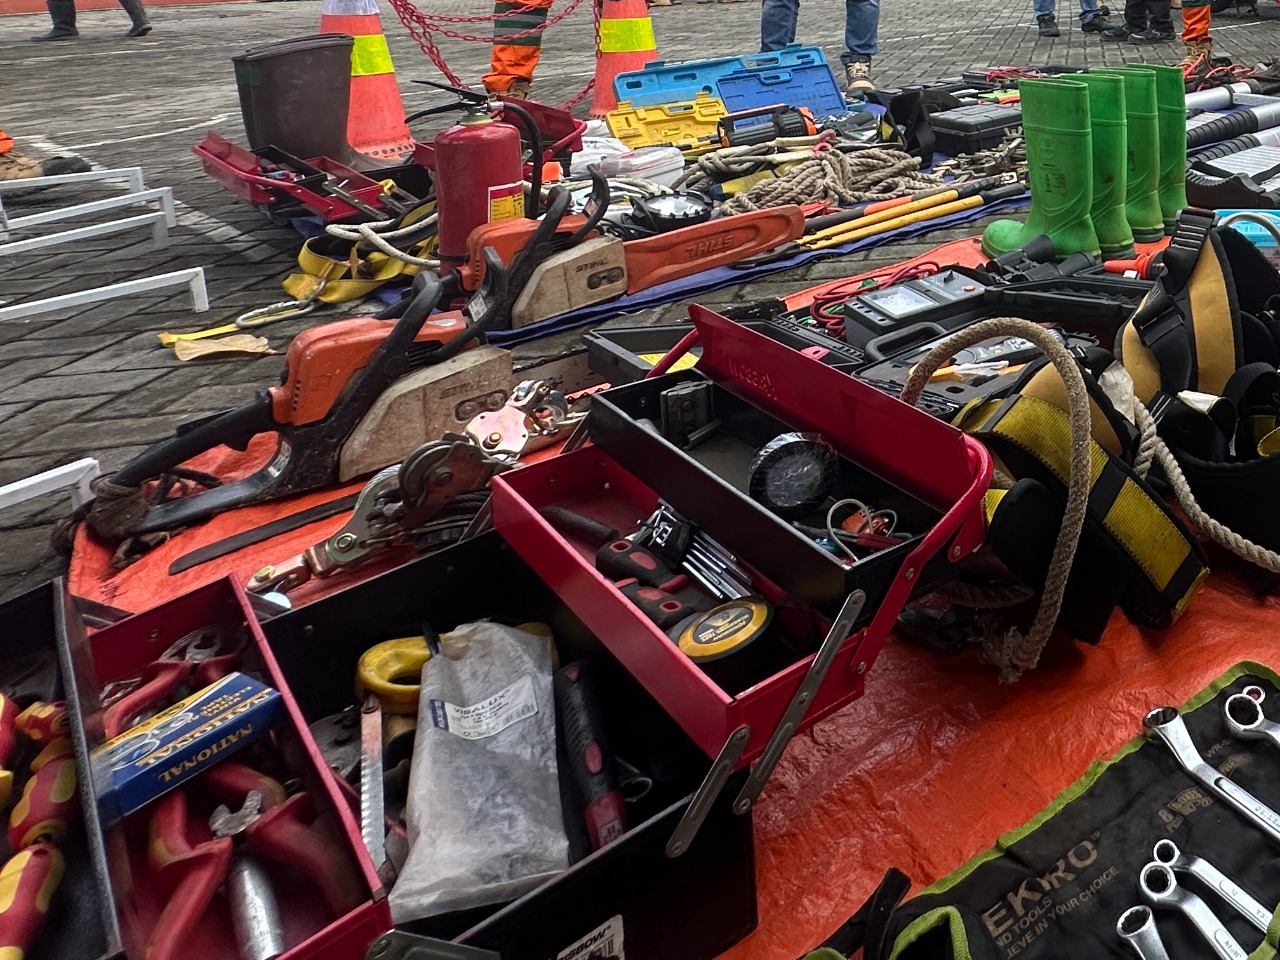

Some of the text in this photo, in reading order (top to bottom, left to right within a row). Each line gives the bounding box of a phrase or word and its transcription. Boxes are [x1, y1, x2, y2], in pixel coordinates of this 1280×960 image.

[145, 687, 274, 765] NATIONAL
[159, 723, 253, 783] NATIONAL
[981, 840, 1098, 938] EKIRO
[996, 895, 1053, 948] ND TOOLS
[1035, 918, 1049, 935] IN
[1047, 897, 1080, 921] YOUR
[1079, 865, 1119, 903] CHOICE
